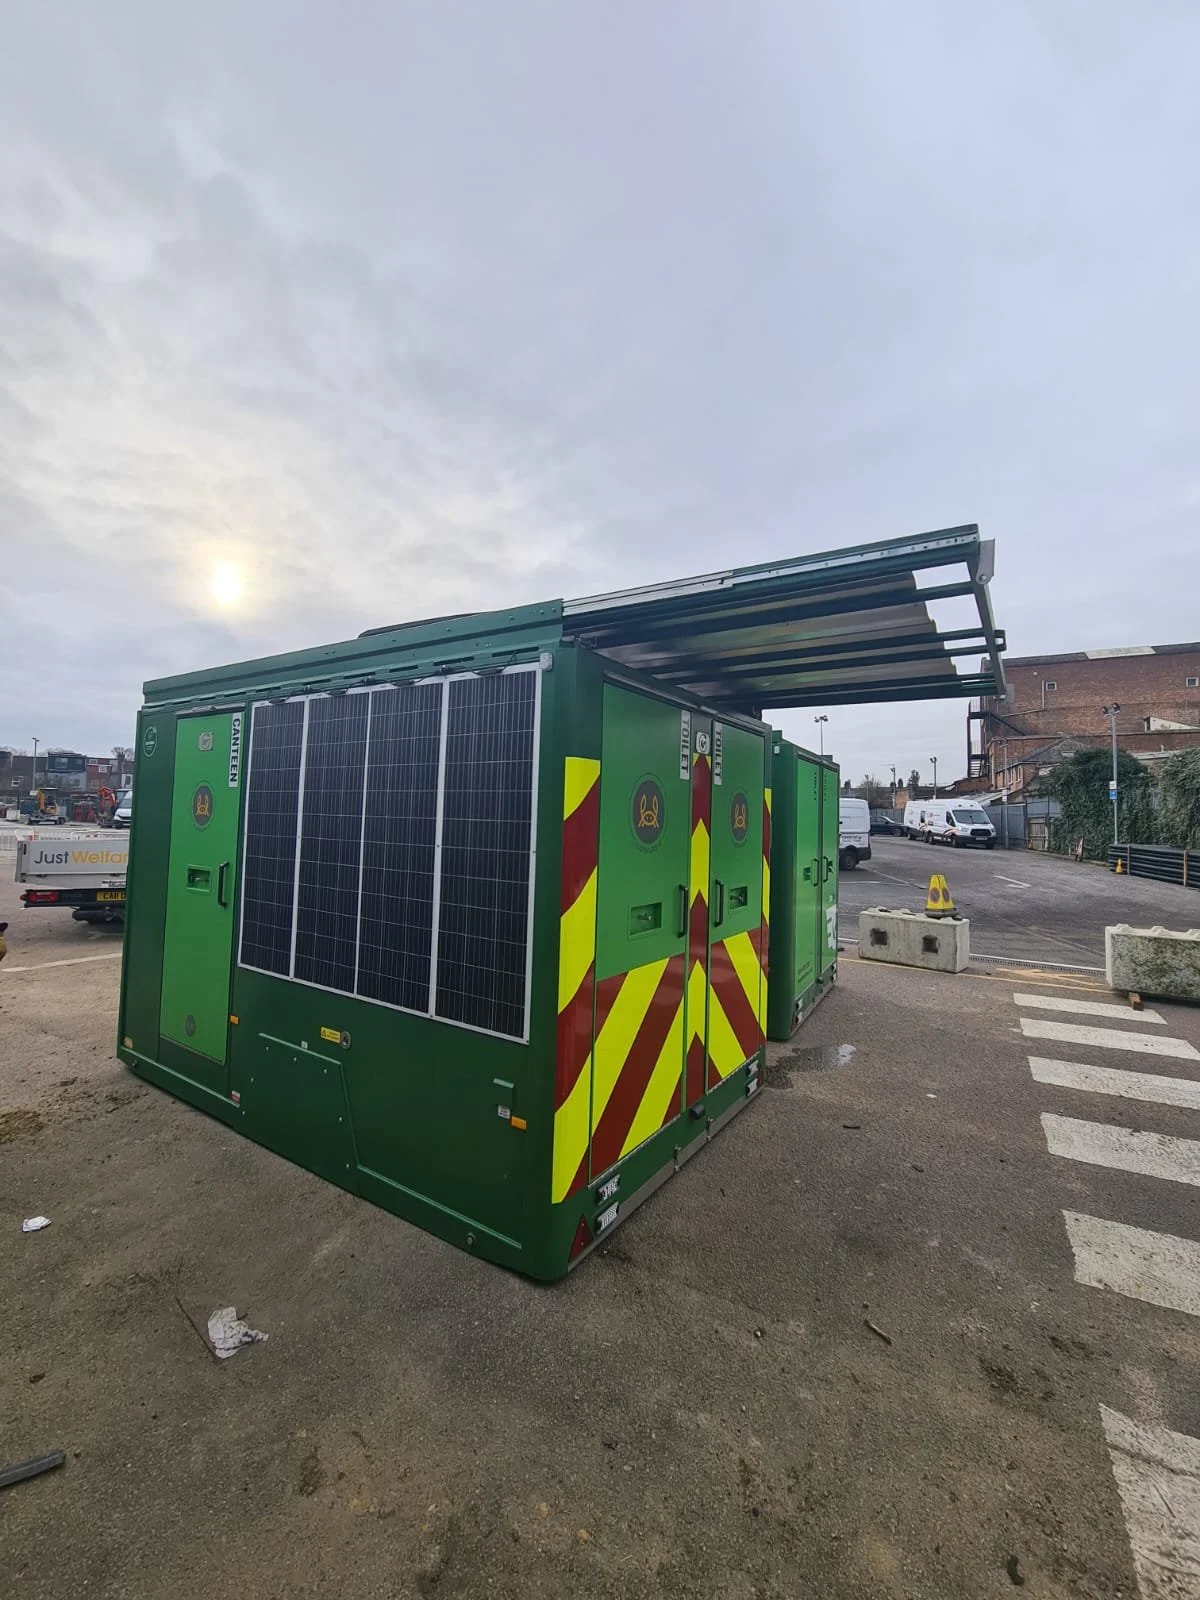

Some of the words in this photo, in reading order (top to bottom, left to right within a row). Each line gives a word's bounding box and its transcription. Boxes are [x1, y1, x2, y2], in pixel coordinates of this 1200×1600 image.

[230, 718, 241, 782] CANTEEN
[681, 718, 690, 773] TOILET
[714, 729, 722, 776] TOILET
[34, 850, 69, 865] Just
